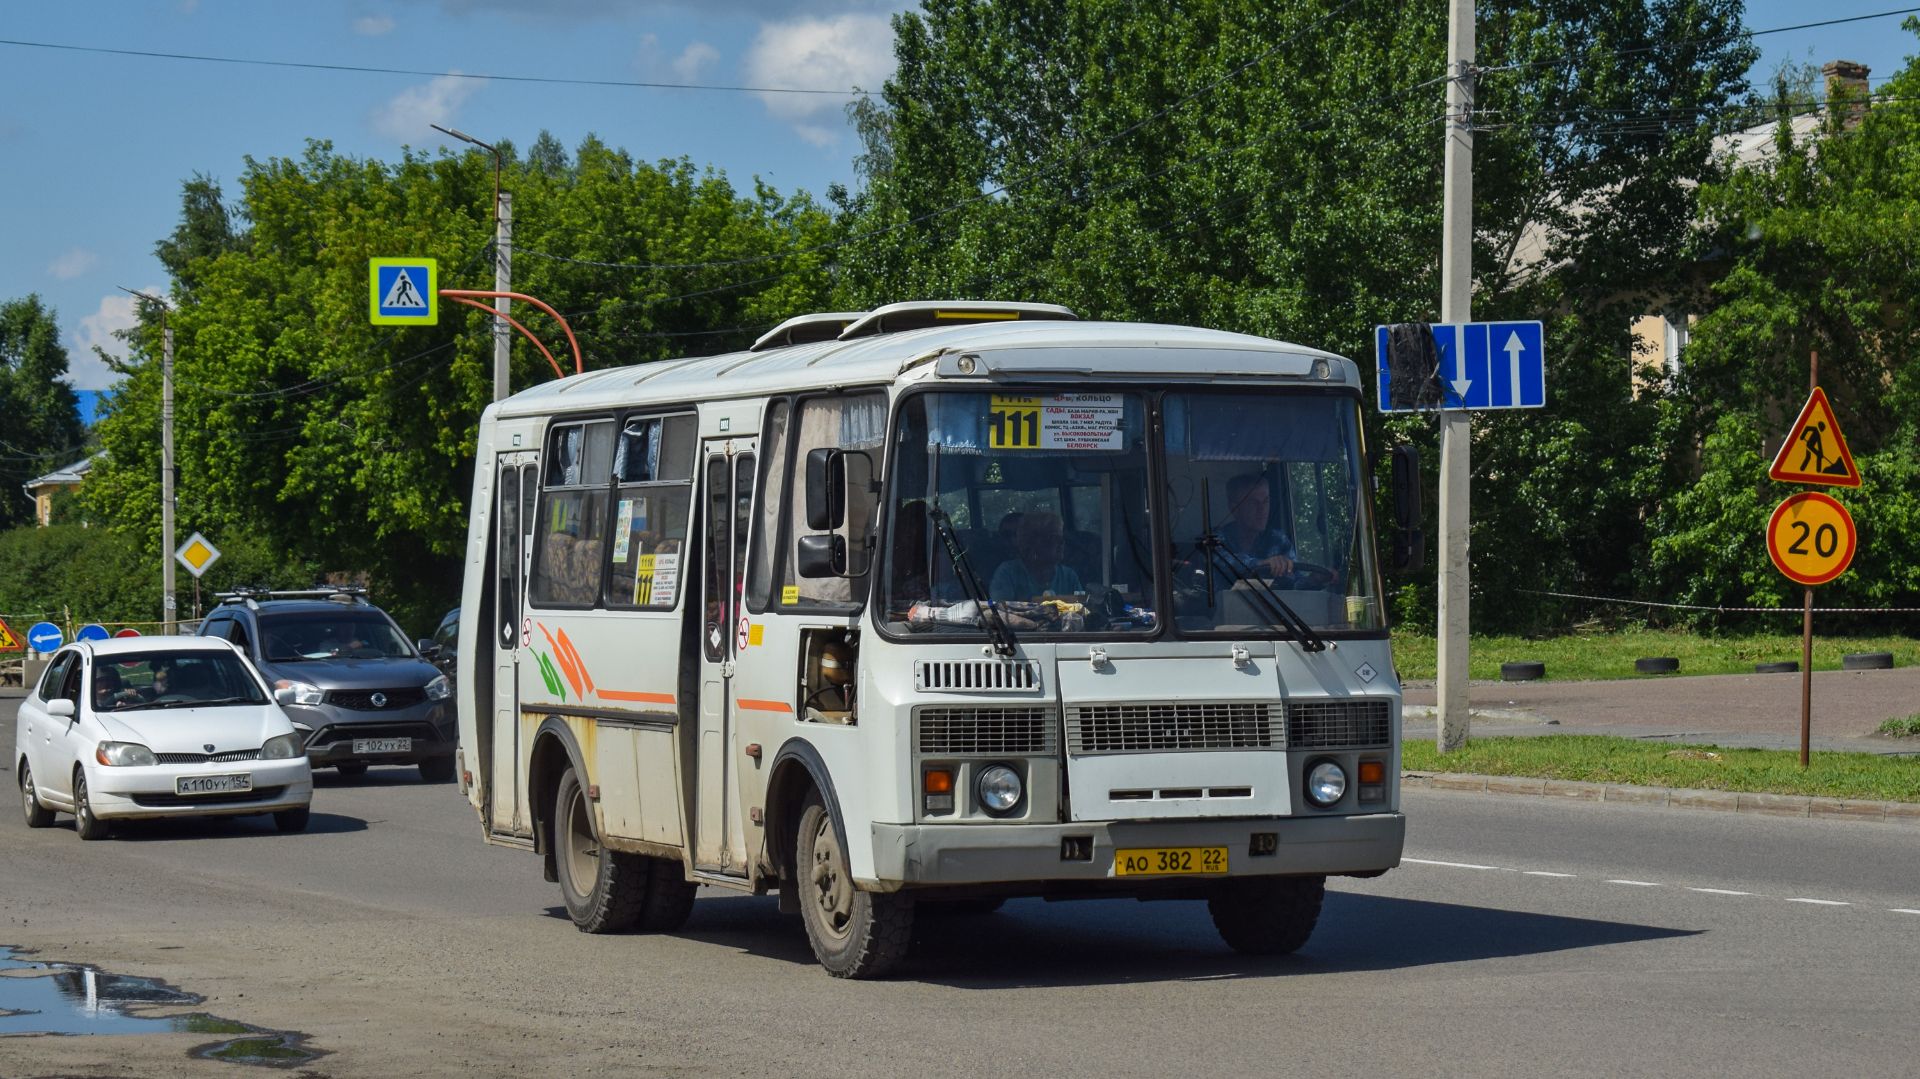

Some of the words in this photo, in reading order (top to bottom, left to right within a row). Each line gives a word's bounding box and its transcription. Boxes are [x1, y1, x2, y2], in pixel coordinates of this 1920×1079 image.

[1075, 394, 1112, 404] КОЛЬЦО
[990, 410, 1038, 446] 111
[1788, 520, 1838, 558] 20
[636, 574, 654, 605] 111
[230, 775, 249, 785] 154
[1157, 851, 1192, 871] 382
[1203, 849, 1221, 865] 22
